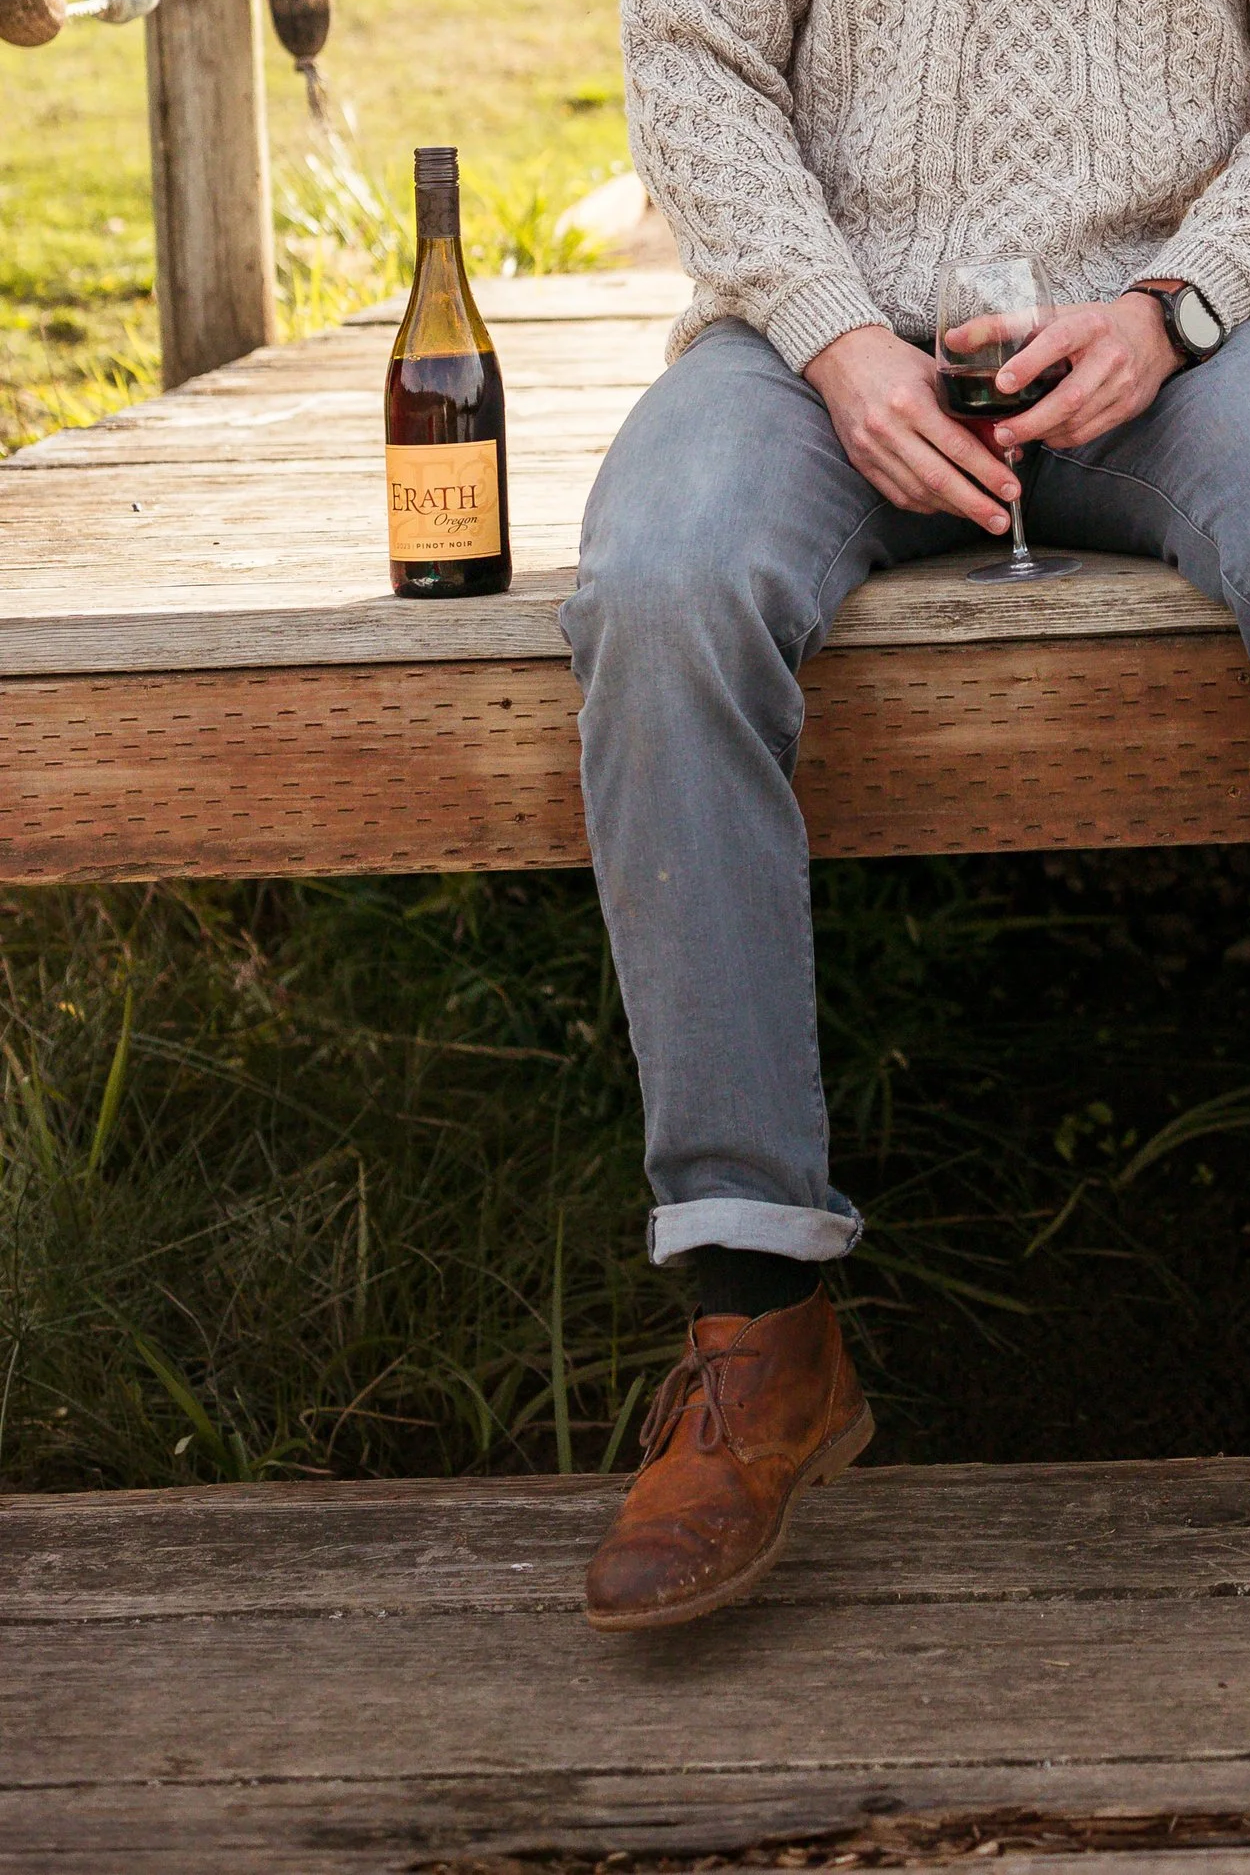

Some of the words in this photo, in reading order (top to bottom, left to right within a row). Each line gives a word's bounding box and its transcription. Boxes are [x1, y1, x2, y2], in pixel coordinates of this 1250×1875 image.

[391, 482, 478, 515] ERATH
[433, 512, 478, 534] Oregon
[449, 540, 473, 548] NOIR
